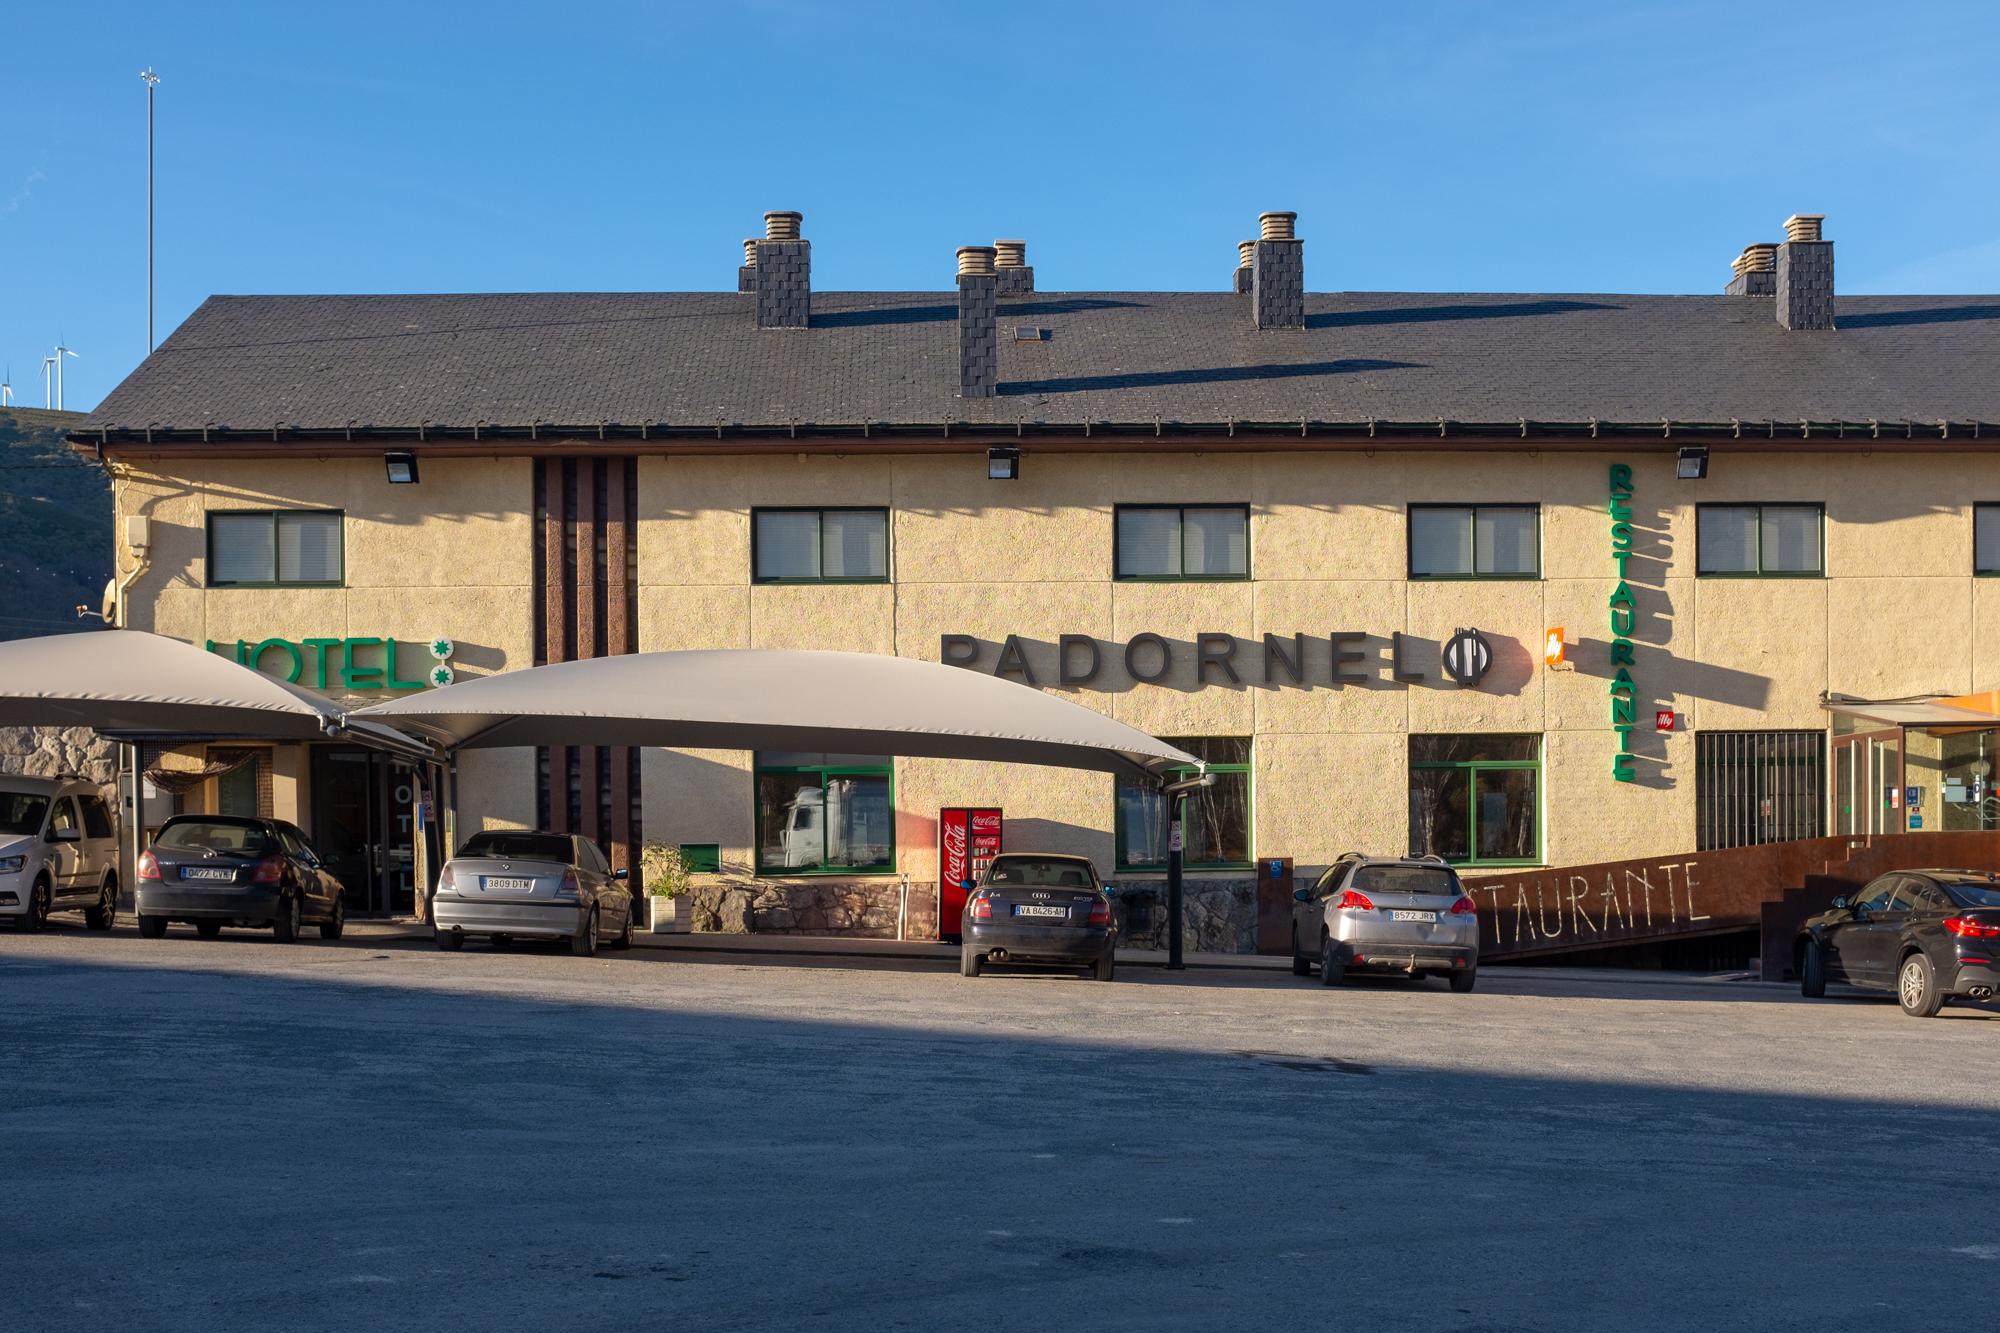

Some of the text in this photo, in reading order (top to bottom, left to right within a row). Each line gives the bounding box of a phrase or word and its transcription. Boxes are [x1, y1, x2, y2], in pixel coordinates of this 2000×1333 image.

[1609, 463, 1636, 782] RESTAURANTE
[206, 637, 427, 690] OTEL
[1657, 713, 1673, 729] illy
[488, 879, 530, 889] 3809 DTM
[1394, 911, 1435, 920] 8572 JRX
[1468, 861, 1712, 945] TAURANTE
